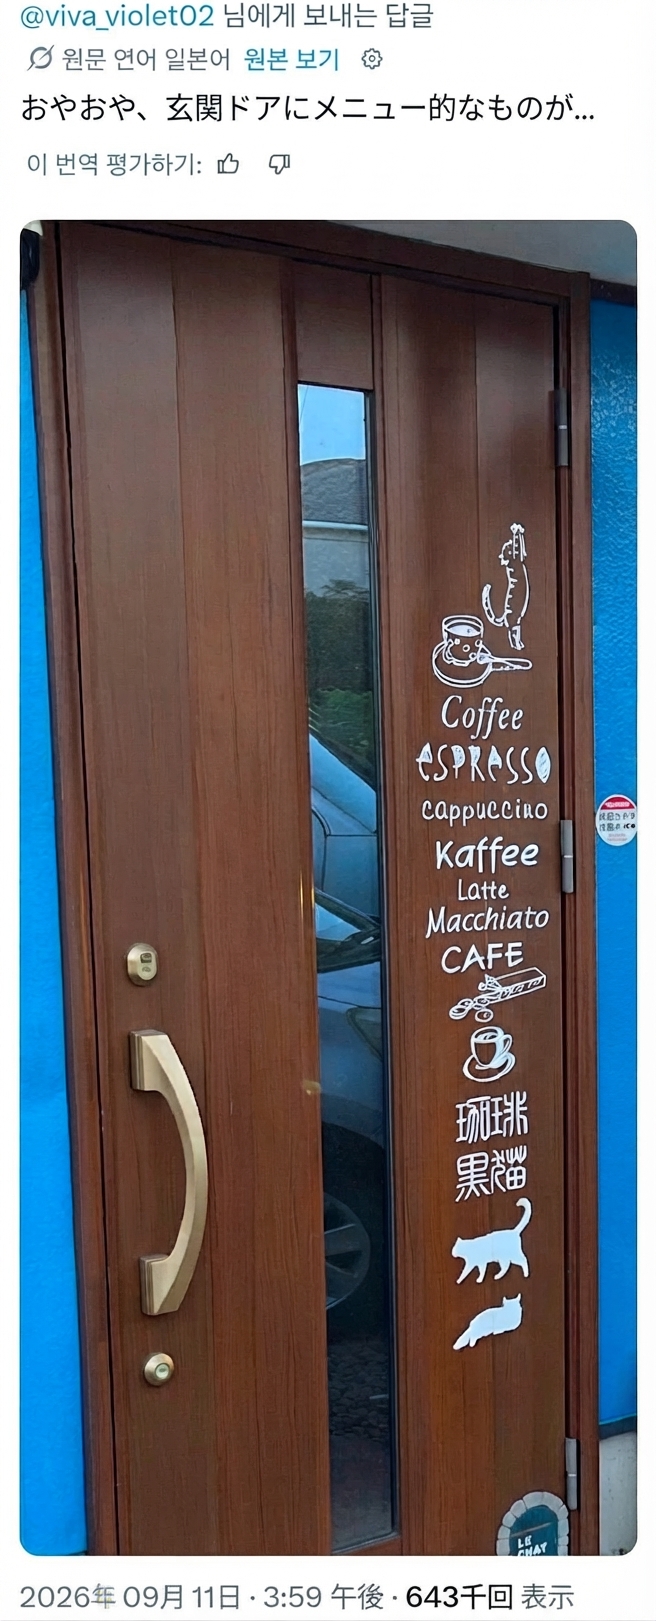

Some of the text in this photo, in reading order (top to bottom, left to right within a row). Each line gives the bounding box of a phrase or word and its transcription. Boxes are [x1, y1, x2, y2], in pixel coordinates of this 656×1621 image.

[441, 695, 524, 739] Coffee
[421, 799, 548, 827] cappuccino
[435, 836, 539, 874] Kaffee
[458, 879, 509, 901] Latte
[425, 906, 549, 938] Macchiato
[441, 942, 524, 974] CAFE
[455, 1145, 528, 1202] 黒猫
